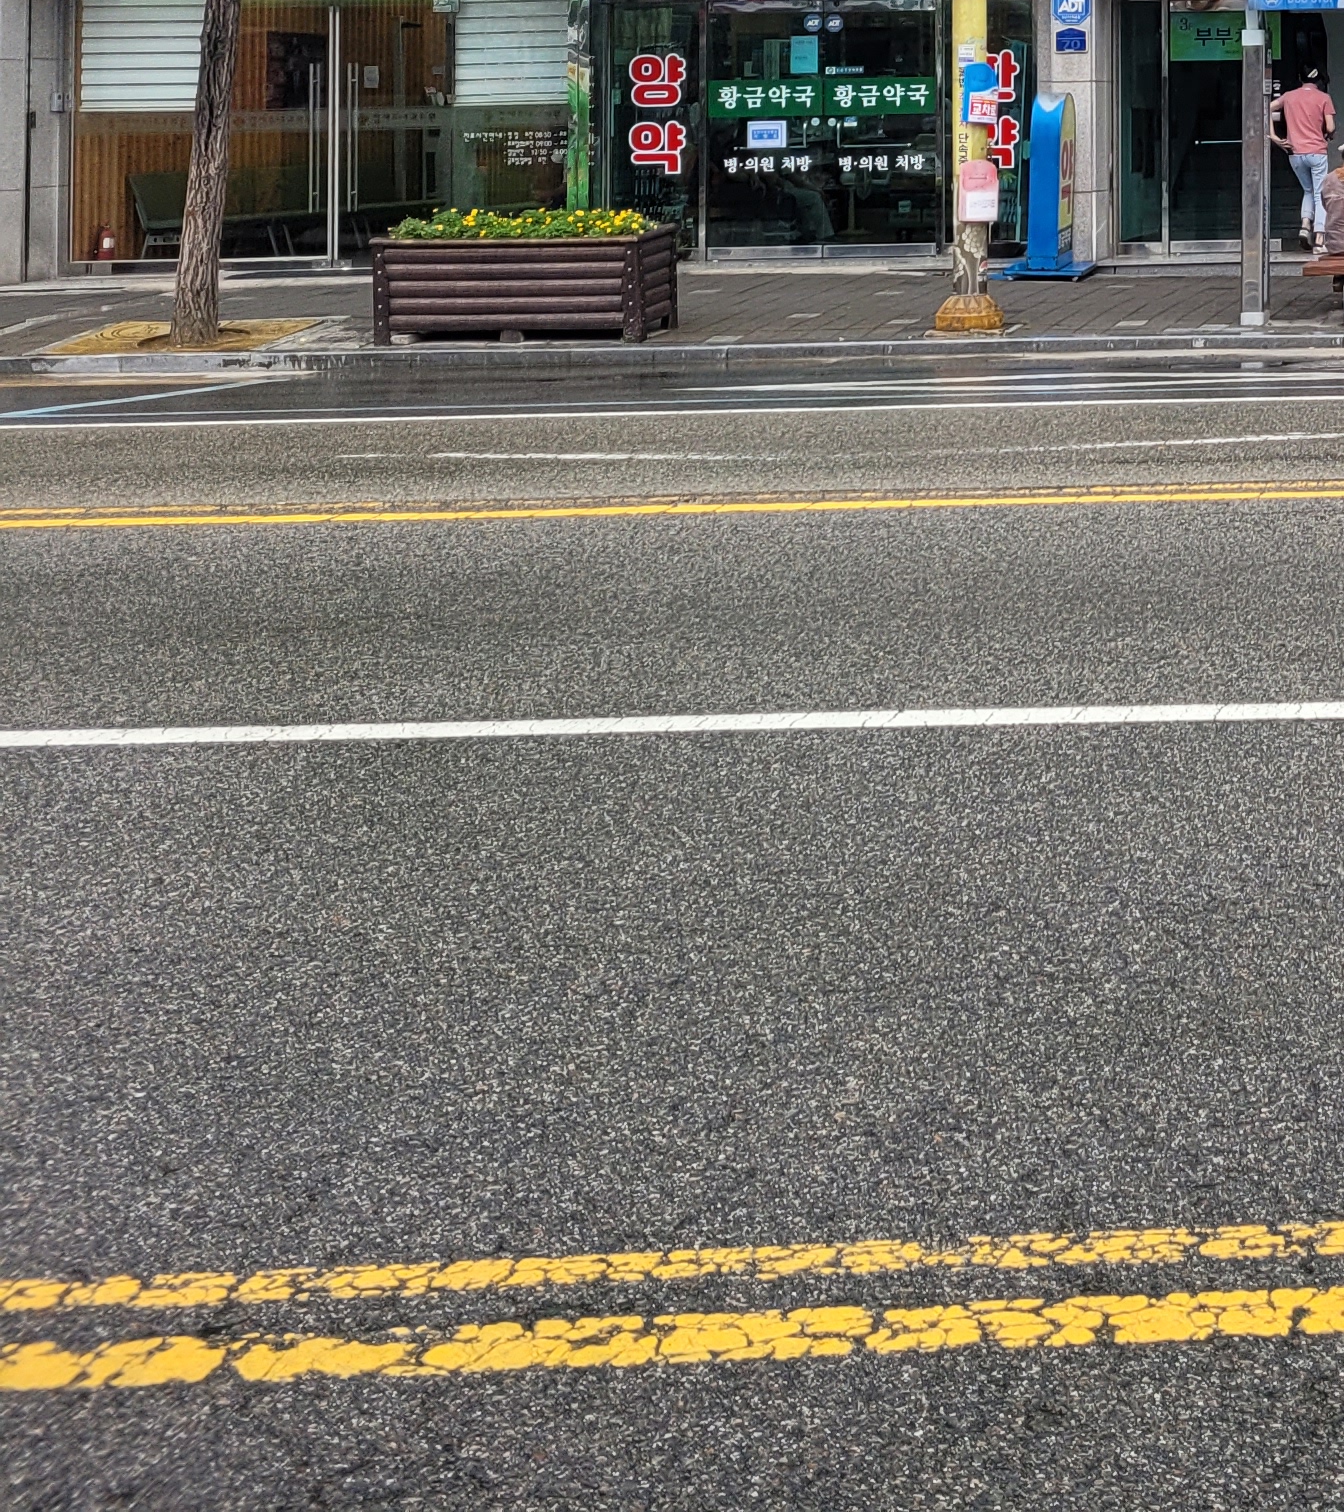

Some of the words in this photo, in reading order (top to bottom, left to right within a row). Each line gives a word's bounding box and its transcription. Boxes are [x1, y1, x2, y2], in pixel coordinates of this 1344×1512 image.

[1058, 0, 1085, 14] ADT
[1060, 39, 1081, 50] 70
[717, 84, 816, 110] 황금약국
[832, 83, 930, 108] 황금약국
[628, 52, 687, 175] 양약
[723, 156, 775, 173] 병·의원
[781, 155, 812, 172] 처방
[838, 155, 889, 172] 병·의원
[895, 154, 926, 171] 처방
